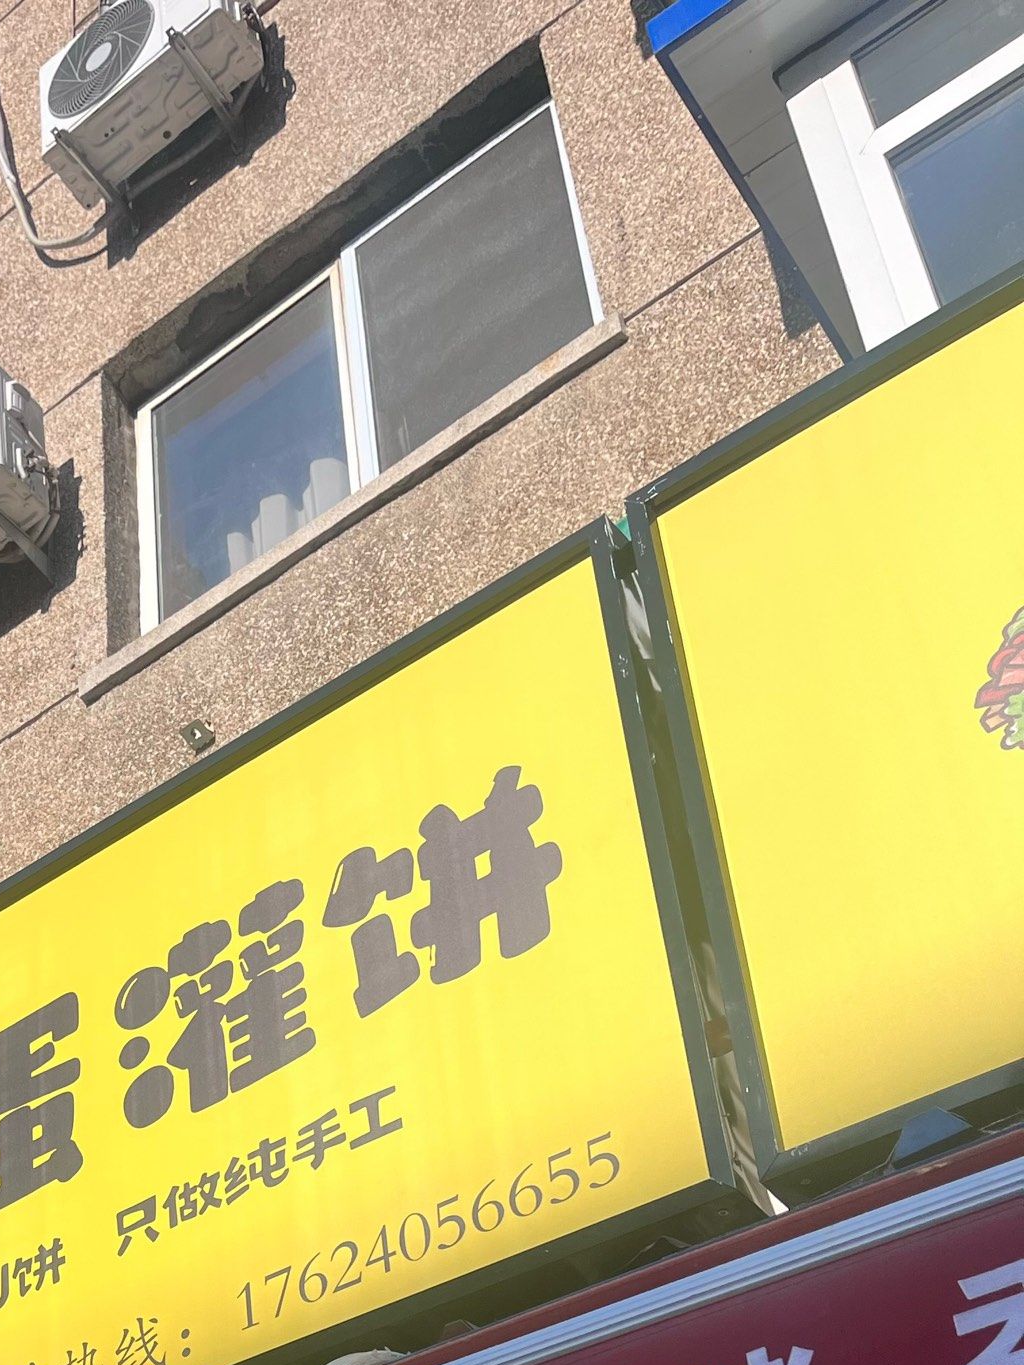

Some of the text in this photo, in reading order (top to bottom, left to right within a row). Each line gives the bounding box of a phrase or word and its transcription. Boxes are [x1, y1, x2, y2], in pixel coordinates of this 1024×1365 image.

[116, 1086, 403, 1257] 只做纯手工
[236, 1131, 622, 1331] 17624056655
